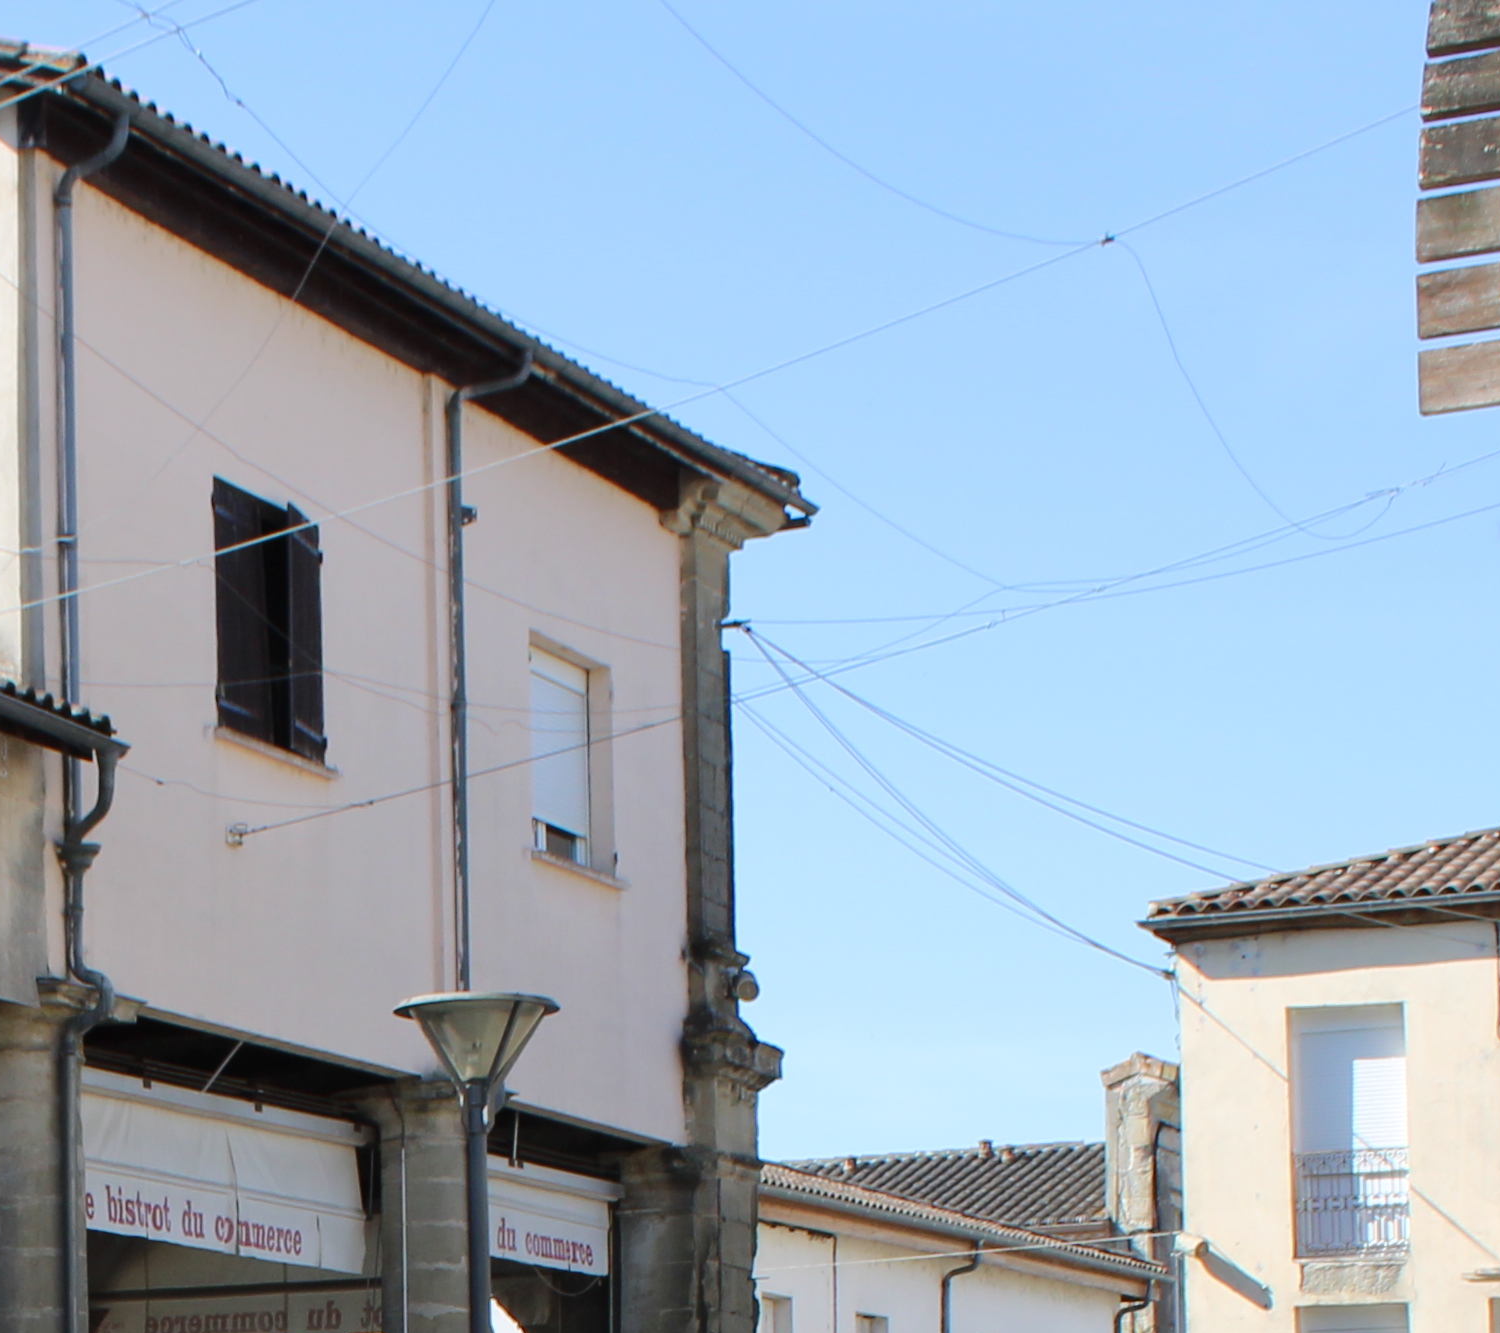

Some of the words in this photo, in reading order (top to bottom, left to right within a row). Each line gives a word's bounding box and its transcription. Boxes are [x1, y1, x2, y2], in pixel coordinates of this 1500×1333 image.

[105, 1184, 172, 1234] bistrot
[182, 1200, 205, 1239] du
[497, 1217, 516, 1251] du
[525, 1232, 594, 1267] commerce
